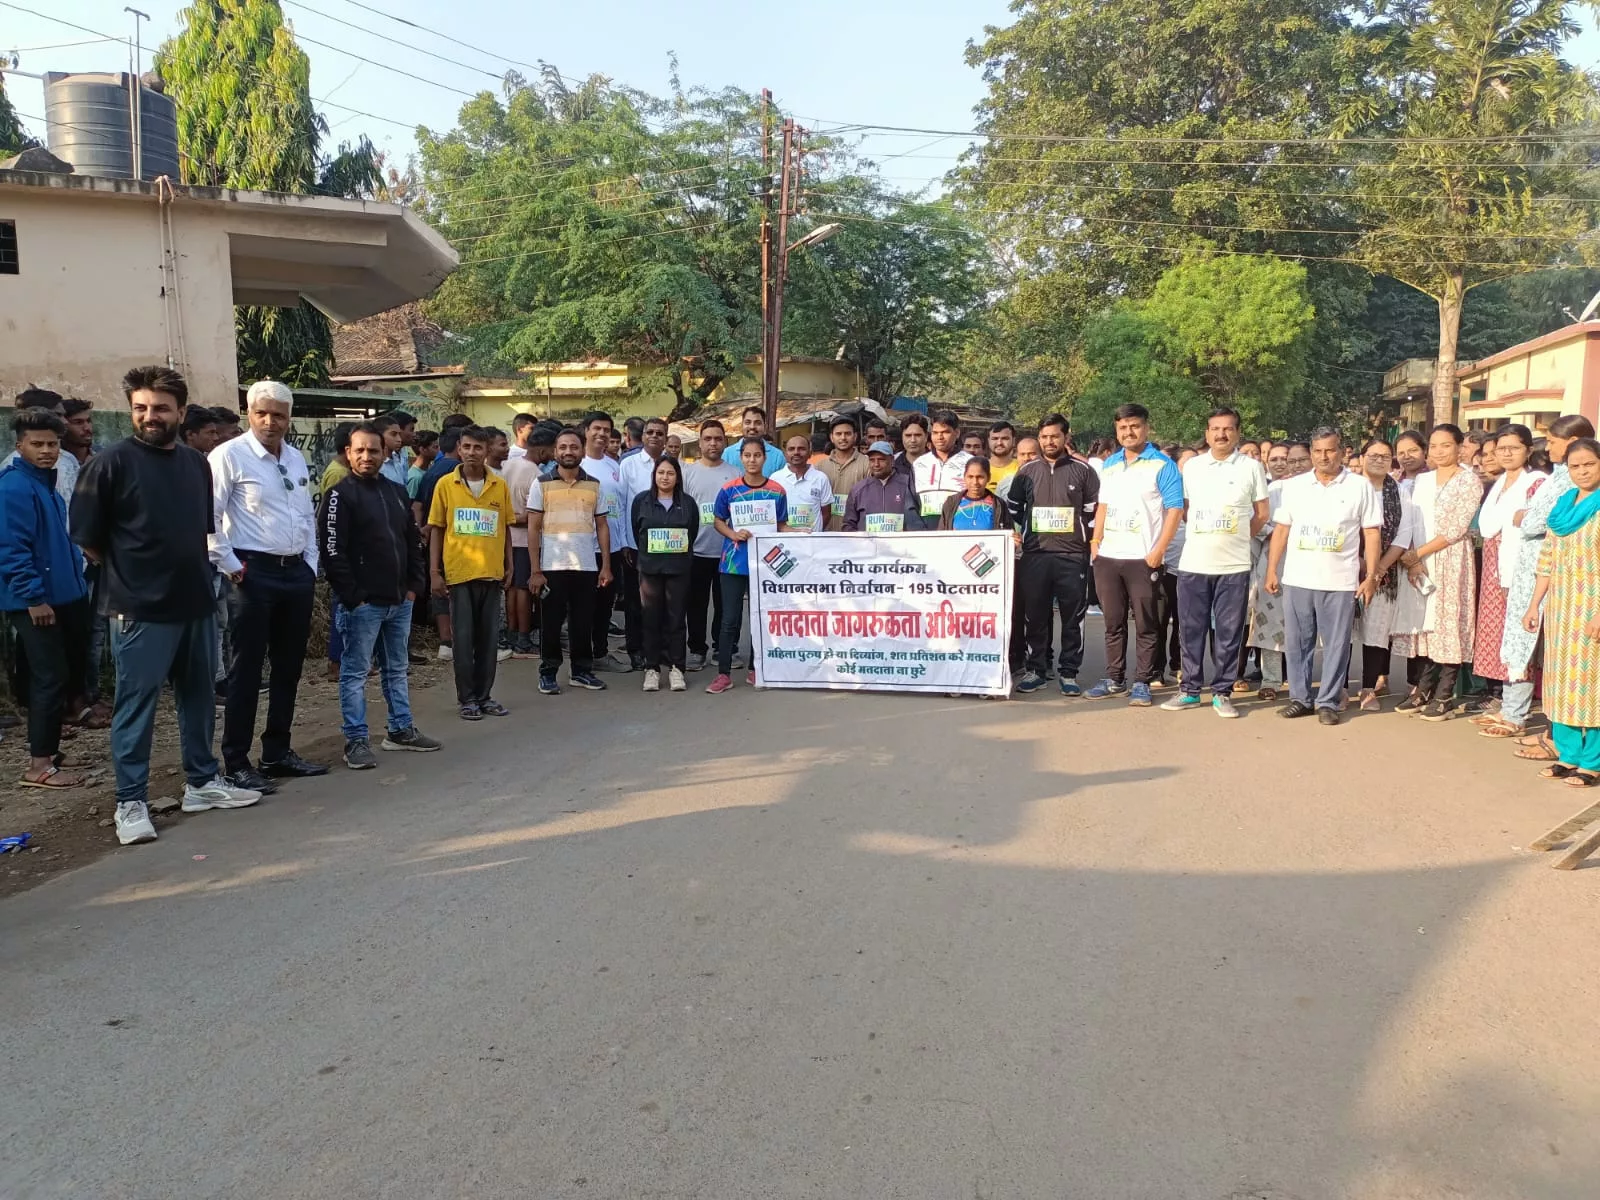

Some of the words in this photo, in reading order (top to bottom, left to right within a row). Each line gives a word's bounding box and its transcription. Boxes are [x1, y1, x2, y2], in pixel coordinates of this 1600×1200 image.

[702, 504, 715, 514] RU
[734, 504, 754, 515] RUN
[1035, 508, 1054, 520] RUN
[457, 510, 481, 521] RUN
[749, 513, 769, 522] VOTE
[793, 515, 811, 524] VOTE
[868, 515, 885, 525] RUN
[326, 489, 340, 557] AODELIFUSH
[475, 520, 494, 533] VOTE
[879, 523, 897, 532] VOTE
[1048, 519, 1069, 529] VOTE
[650, 530, 670, 540] RUN
[664, 540, 684, 549] VOTE
[828, 559, 864, 575] स्वीप
[867, 559, 927, 575] कार्यक्रम
[762, 580, 836, 594] विधानसभा
[908, 583, 933, 594] 195
[936, 580, 1000, 595] पेटलावद
[767, 610, 829, 638] मतदाता
[831, 611, 921, 638] जागरुकता
[925, 599, 997, 639] अभियान
[767, 647, 796, 660] महिला
[823, 648, 834, 660] हो
[835, 650, 847, 660] या
[890, 651, 907, 661] शत
[909, 649, 945, 662] प्रतिशत
[966, 652, 1001, 663] मतदान
[836, 661, 856, 674] कोई
[858, 664, 894, 675] मतदाता
